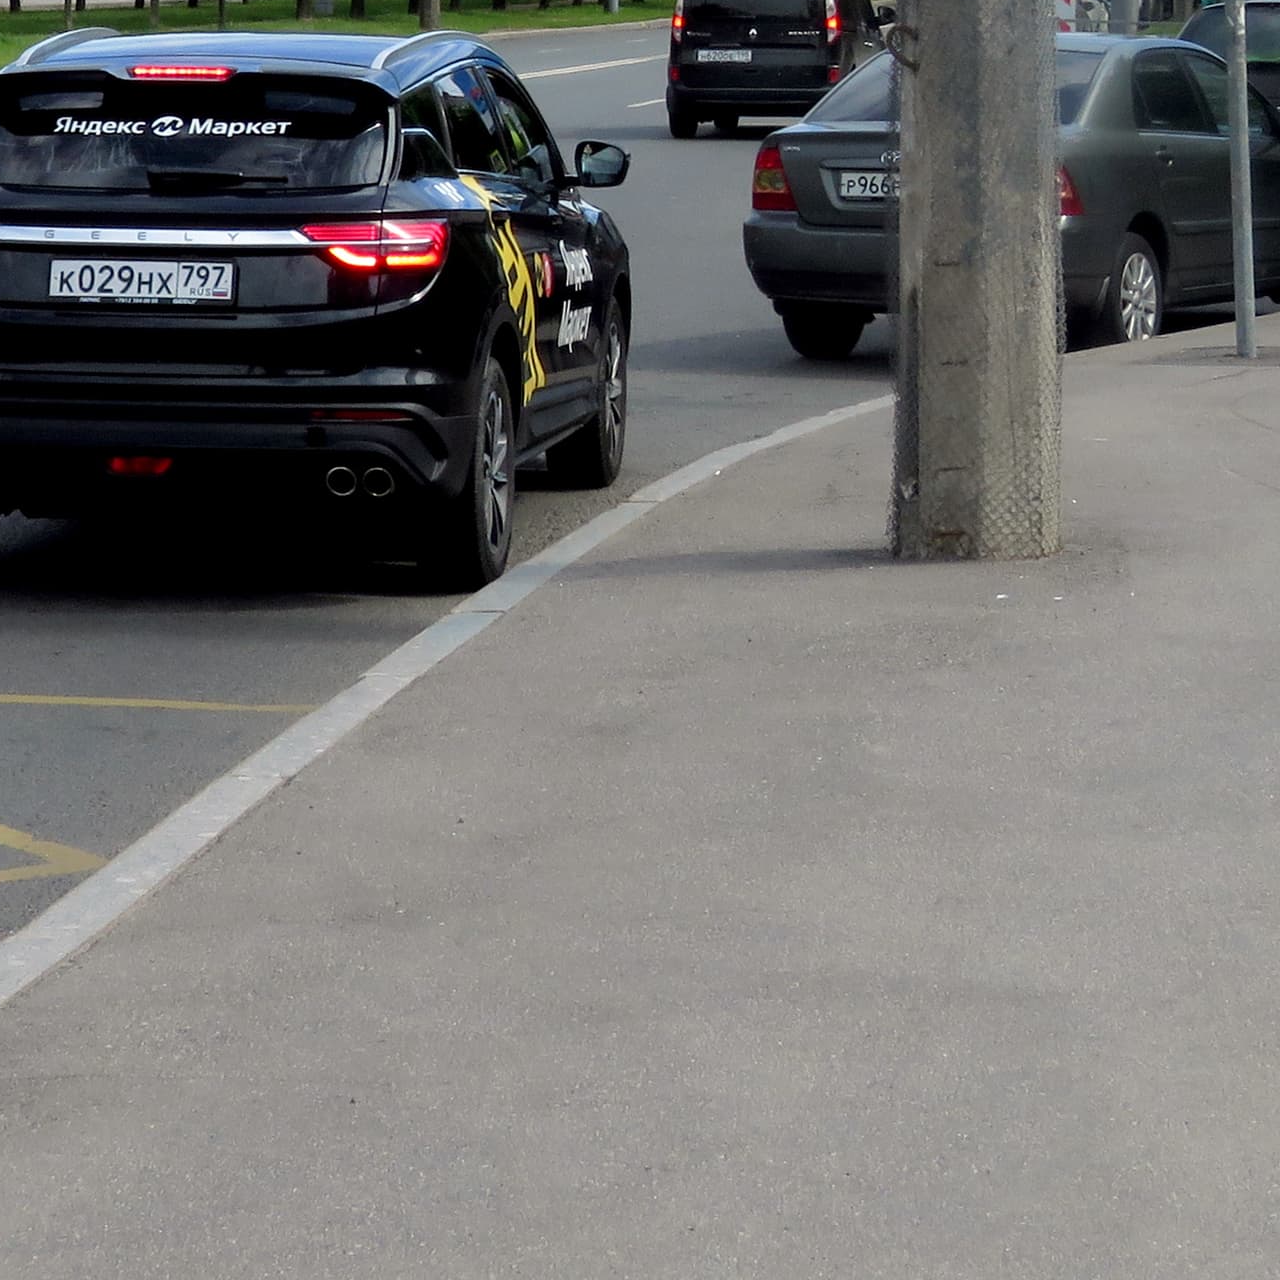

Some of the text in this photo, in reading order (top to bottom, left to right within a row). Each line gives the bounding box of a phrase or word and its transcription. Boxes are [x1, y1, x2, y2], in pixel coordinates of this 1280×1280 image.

[53, 116, 292, 137] Яндекс Маркет
[44, 229, 240, 242] GEELY
[58, 265, 226, 296] К029НХ 797
[190, 288, 212, 296] RUS
